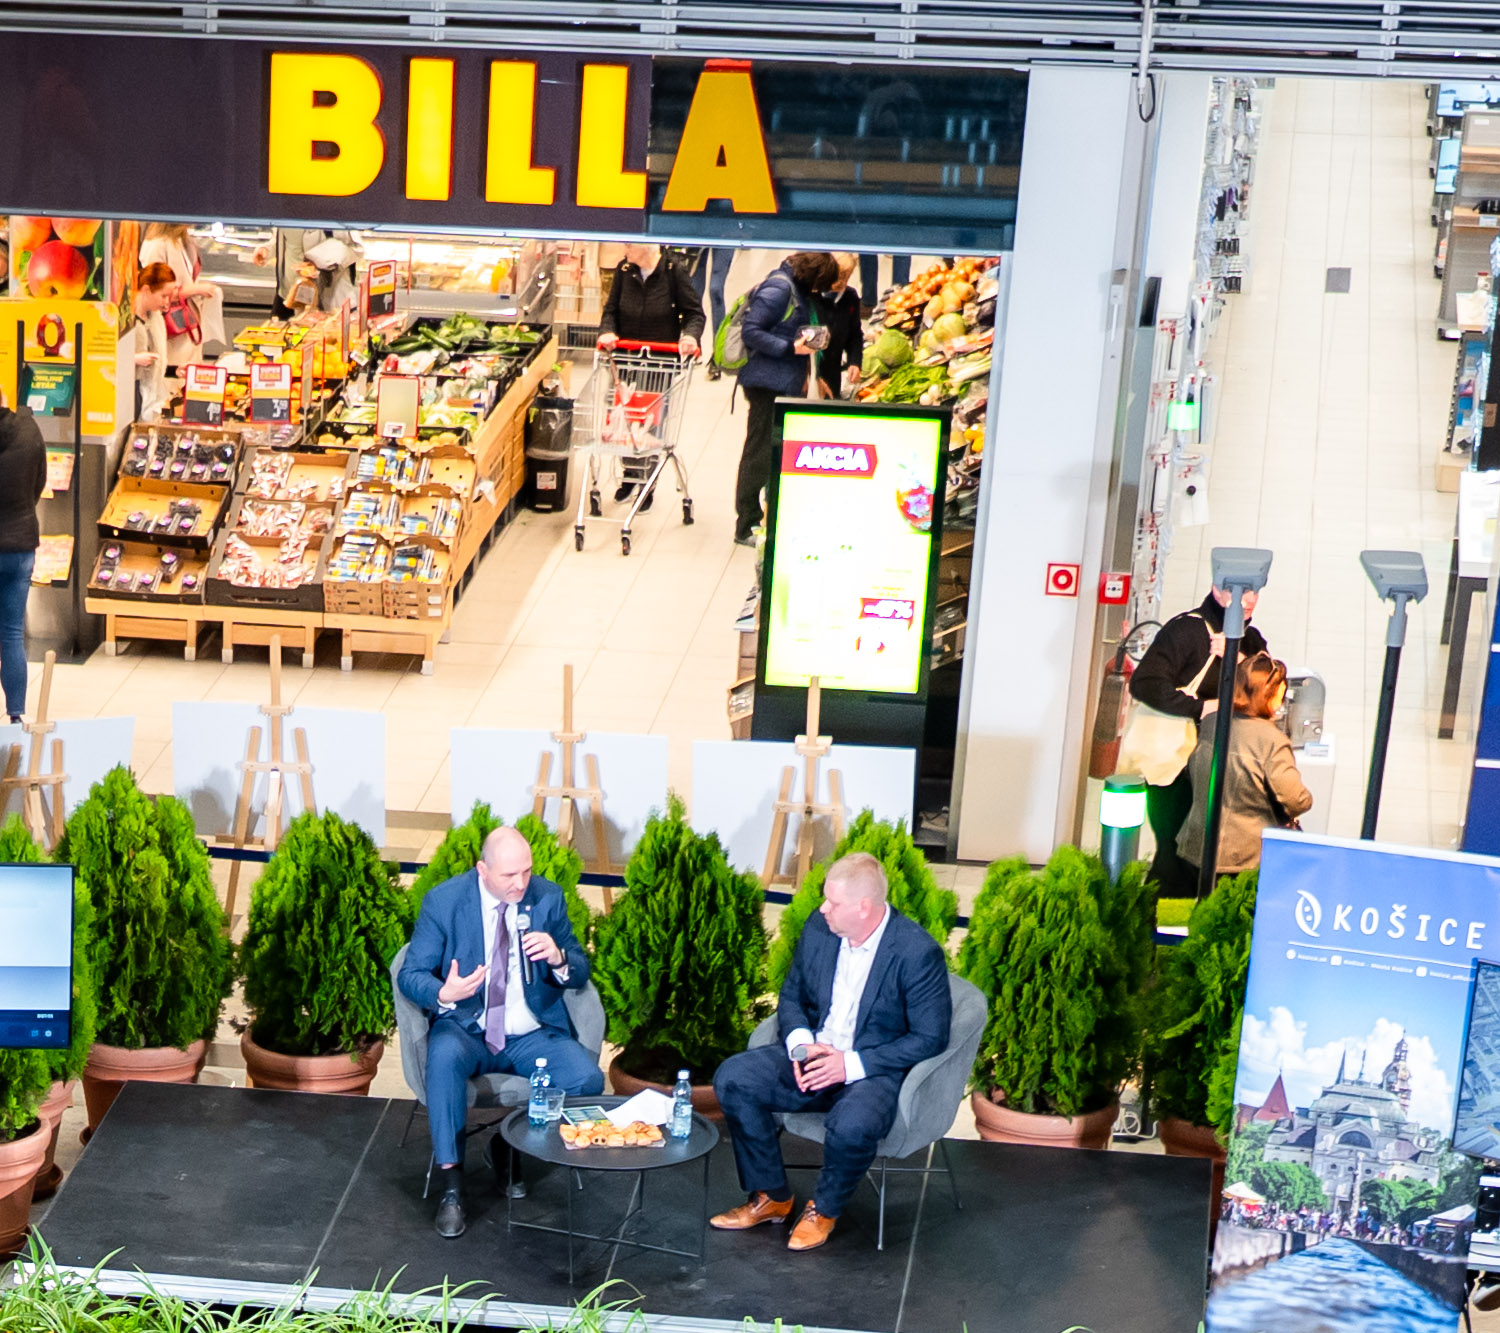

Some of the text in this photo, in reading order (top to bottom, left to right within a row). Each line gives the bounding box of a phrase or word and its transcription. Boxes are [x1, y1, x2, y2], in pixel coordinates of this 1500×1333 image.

[269, 51, 778, 215] BILLA
[795, 445, 870, 472] AKCIA
[1333, 903, 1487, 950] KOŠICE
